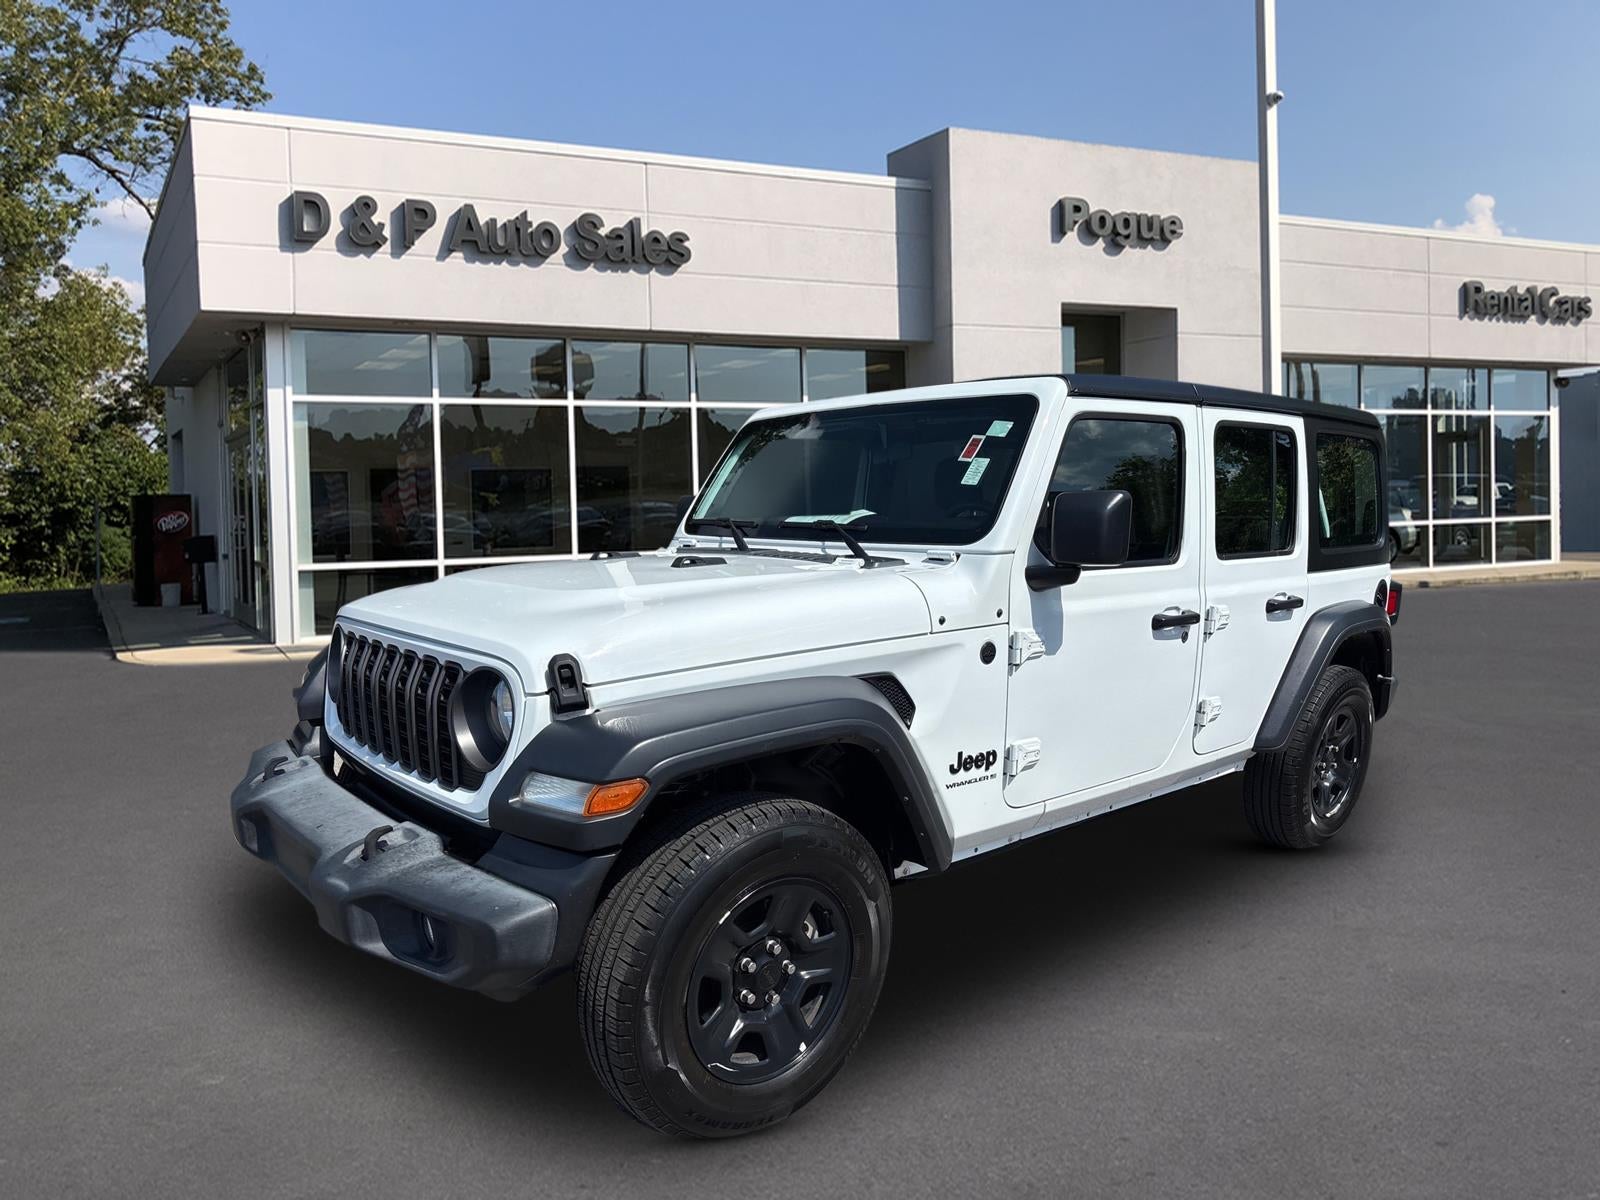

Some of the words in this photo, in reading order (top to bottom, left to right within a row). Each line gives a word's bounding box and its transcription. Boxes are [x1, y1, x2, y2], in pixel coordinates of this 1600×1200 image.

[292, 190, 332, 243] D
[348, 195, 388, 248] &
[403, 199, 437, 248] P
[449, 204, 562, 257] Auto
[574, 213, 692, 266] Sales
[1058, 197, 1184, 247] Pogue
[1462, 280, 1538, 319] Rental
[1539, 286, 1592, 320] Cars
[949, 749, 997, 775] Jeep
[945, 775, 989, 790] WRANGLER
